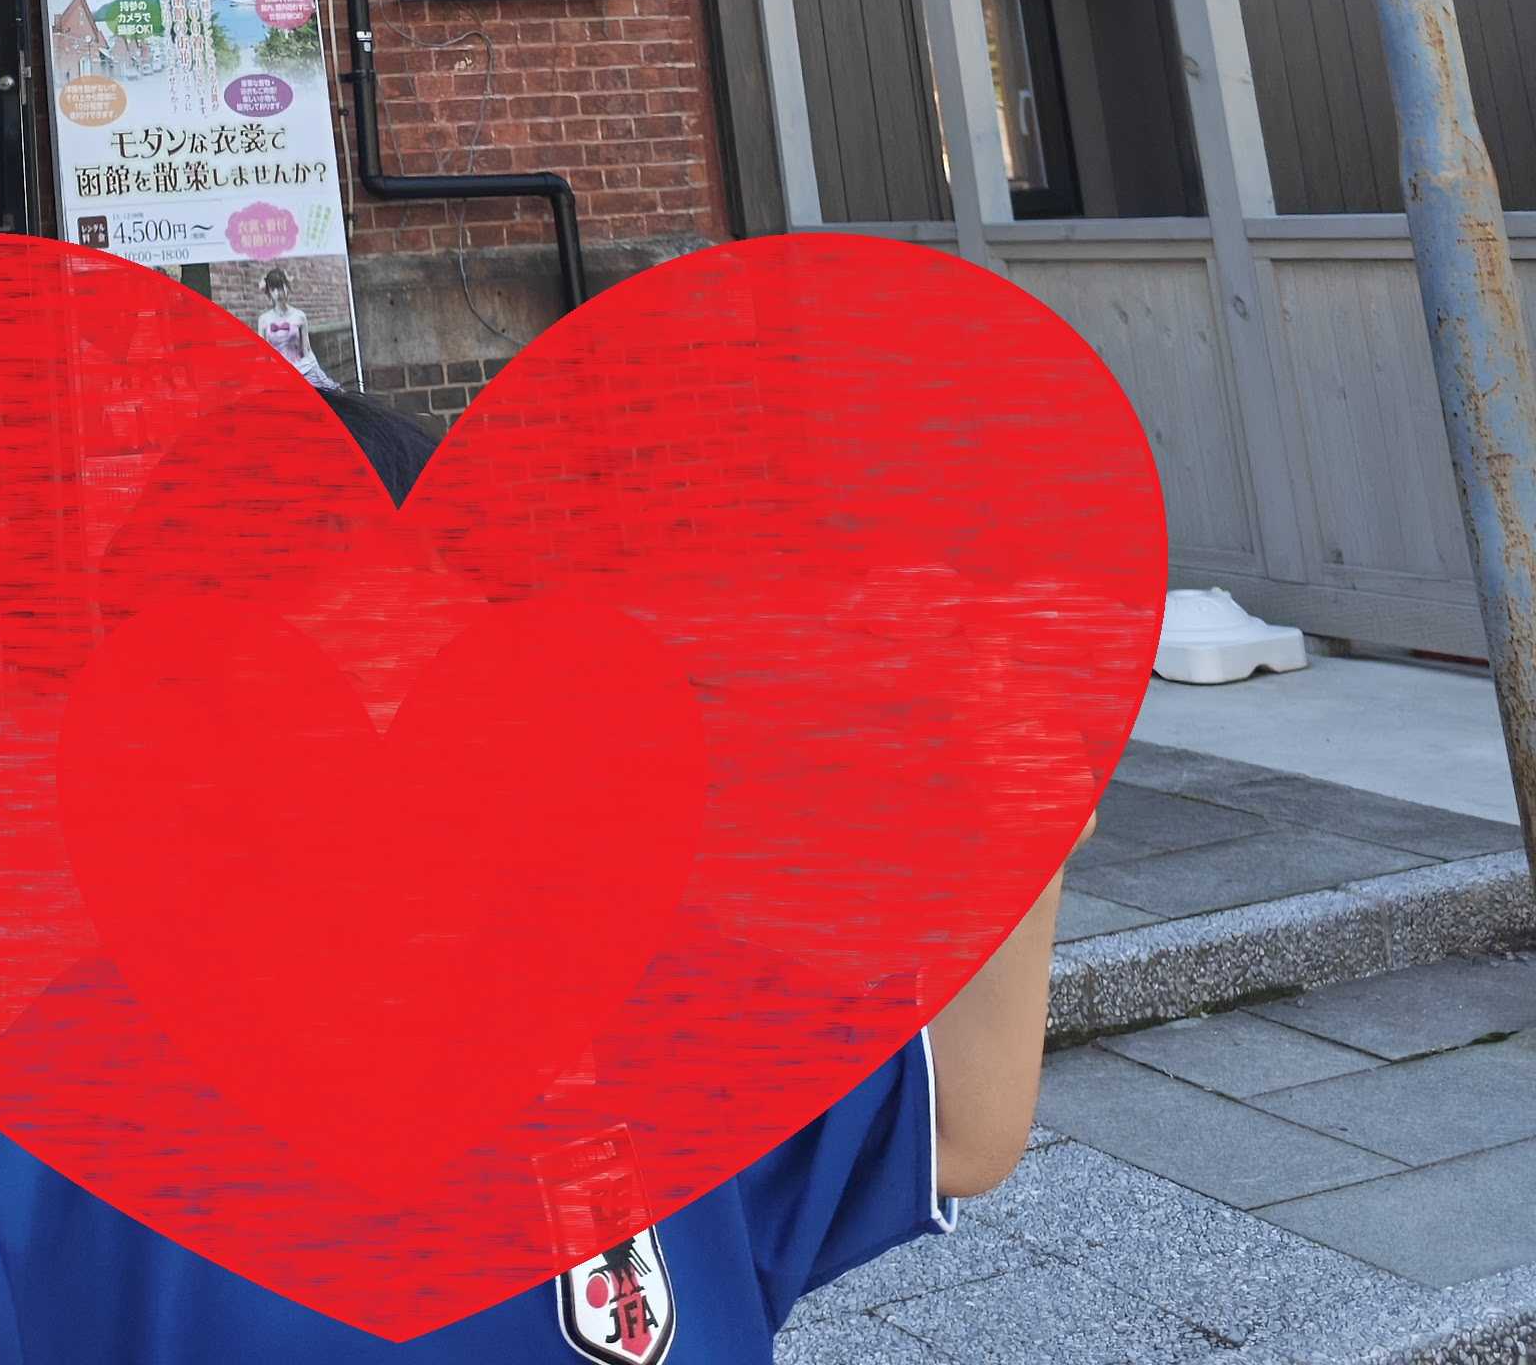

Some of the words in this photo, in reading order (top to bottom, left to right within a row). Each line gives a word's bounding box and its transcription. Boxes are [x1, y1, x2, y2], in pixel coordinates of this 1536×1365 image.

[117, 13, 151, 23] カメラで
[110, 125, 286, 159] モダンな衣裳で
[74, 162, 327, 197] 函館を散策しませんか?
[605, 1295, 659, 1344] JFA
